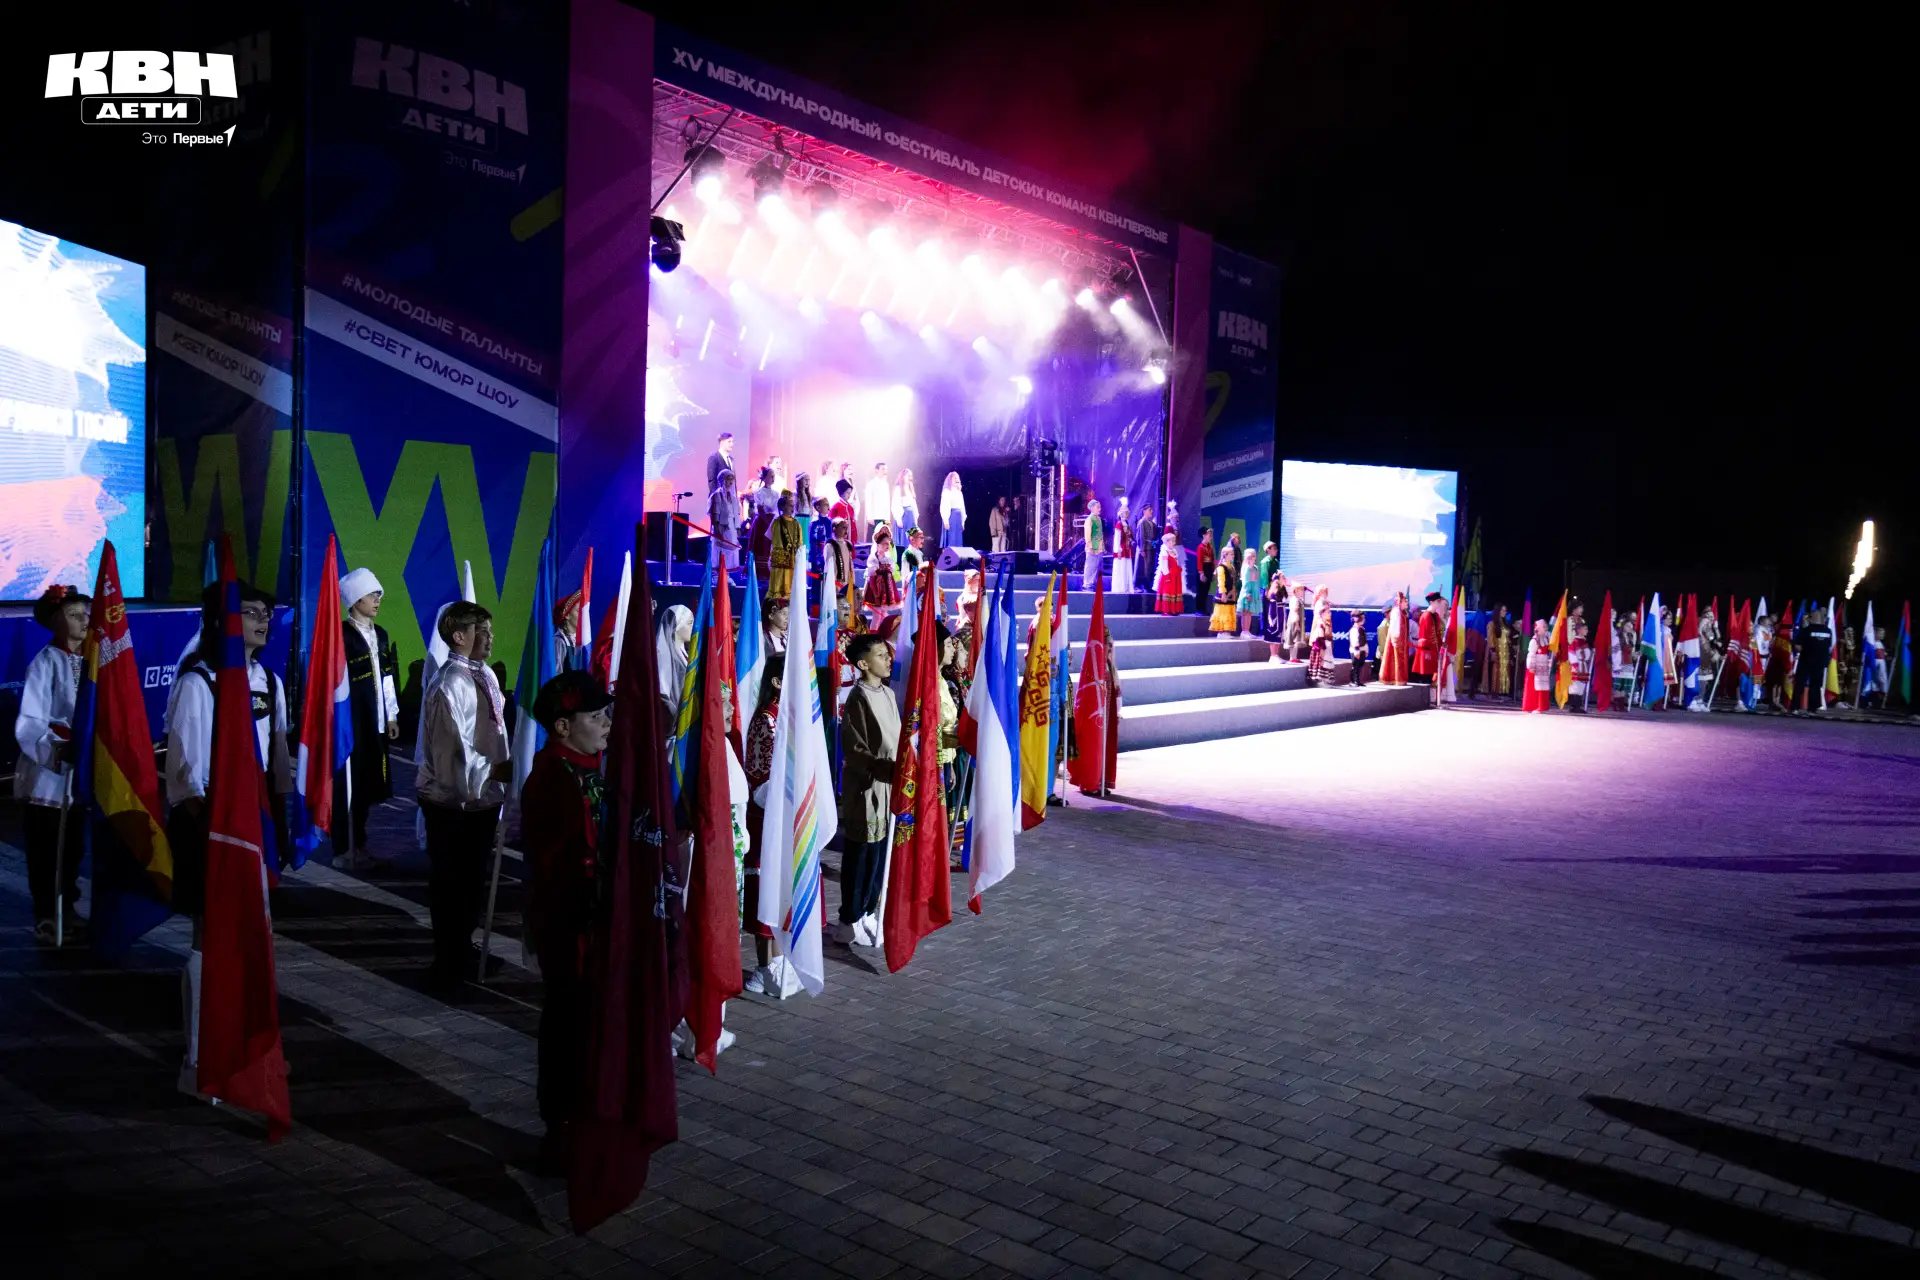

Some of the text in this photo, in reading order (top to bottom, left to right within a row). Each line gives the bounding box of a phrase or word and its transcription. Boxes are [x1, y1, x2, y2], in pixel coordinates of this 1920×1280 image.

[350, 35, 529, 136] КВН
[402, 107, 486, 145] ДЕТИ
[672, 47, 704, 72] XV
[707, 61, 882, 141] МЕЖДУНАРОДНЫЙ
[884, 131, 981, 177] ФЕСТИВАЛЬ
[982, 166, 1044, 200] ДЕТСКИХ
[1046, 189, 1099, 219] КОМАНД
[341, 272, 543, 376] #МОЛОДЫЕ ТАЛАНТЫ
[344, 319, 519, 409] #СВЕТ ЮМОР ШОУ
[1217, 310, 1268, 350] КВН
